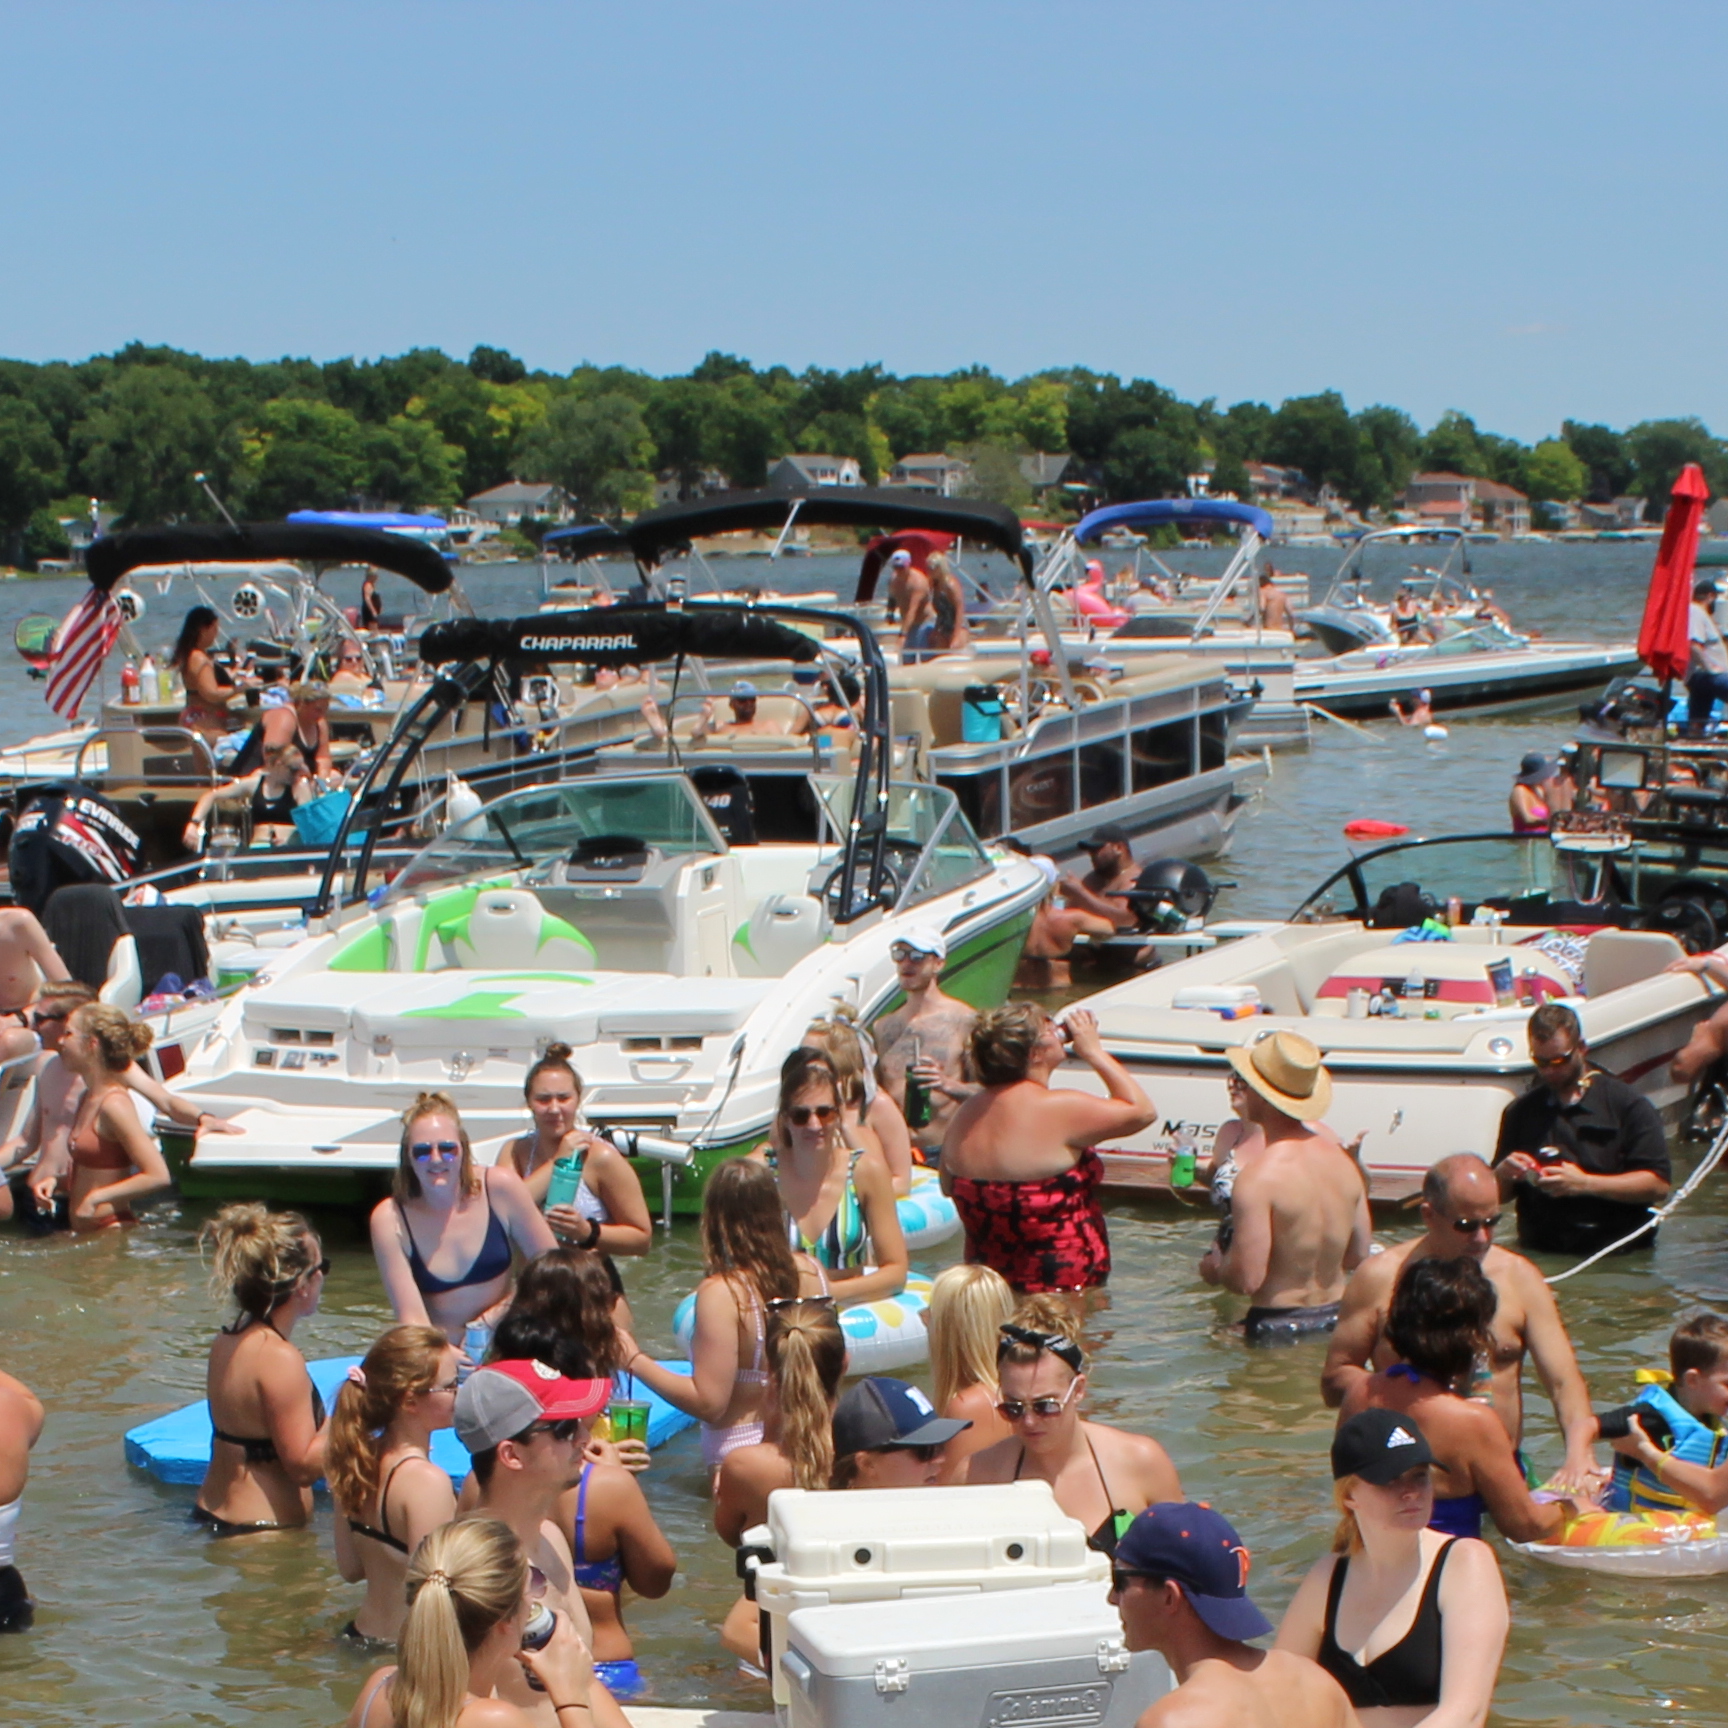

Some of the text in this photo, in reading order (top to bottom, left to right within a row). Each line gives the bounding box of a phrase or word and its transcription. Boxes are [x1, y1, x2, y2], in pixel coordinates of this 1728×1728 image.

[520, 634, 638, 651] CHAPARRAL
[79, 797, 141, 850] EVINRUDE
[997, 1695, 1080, 1719] Coleman
